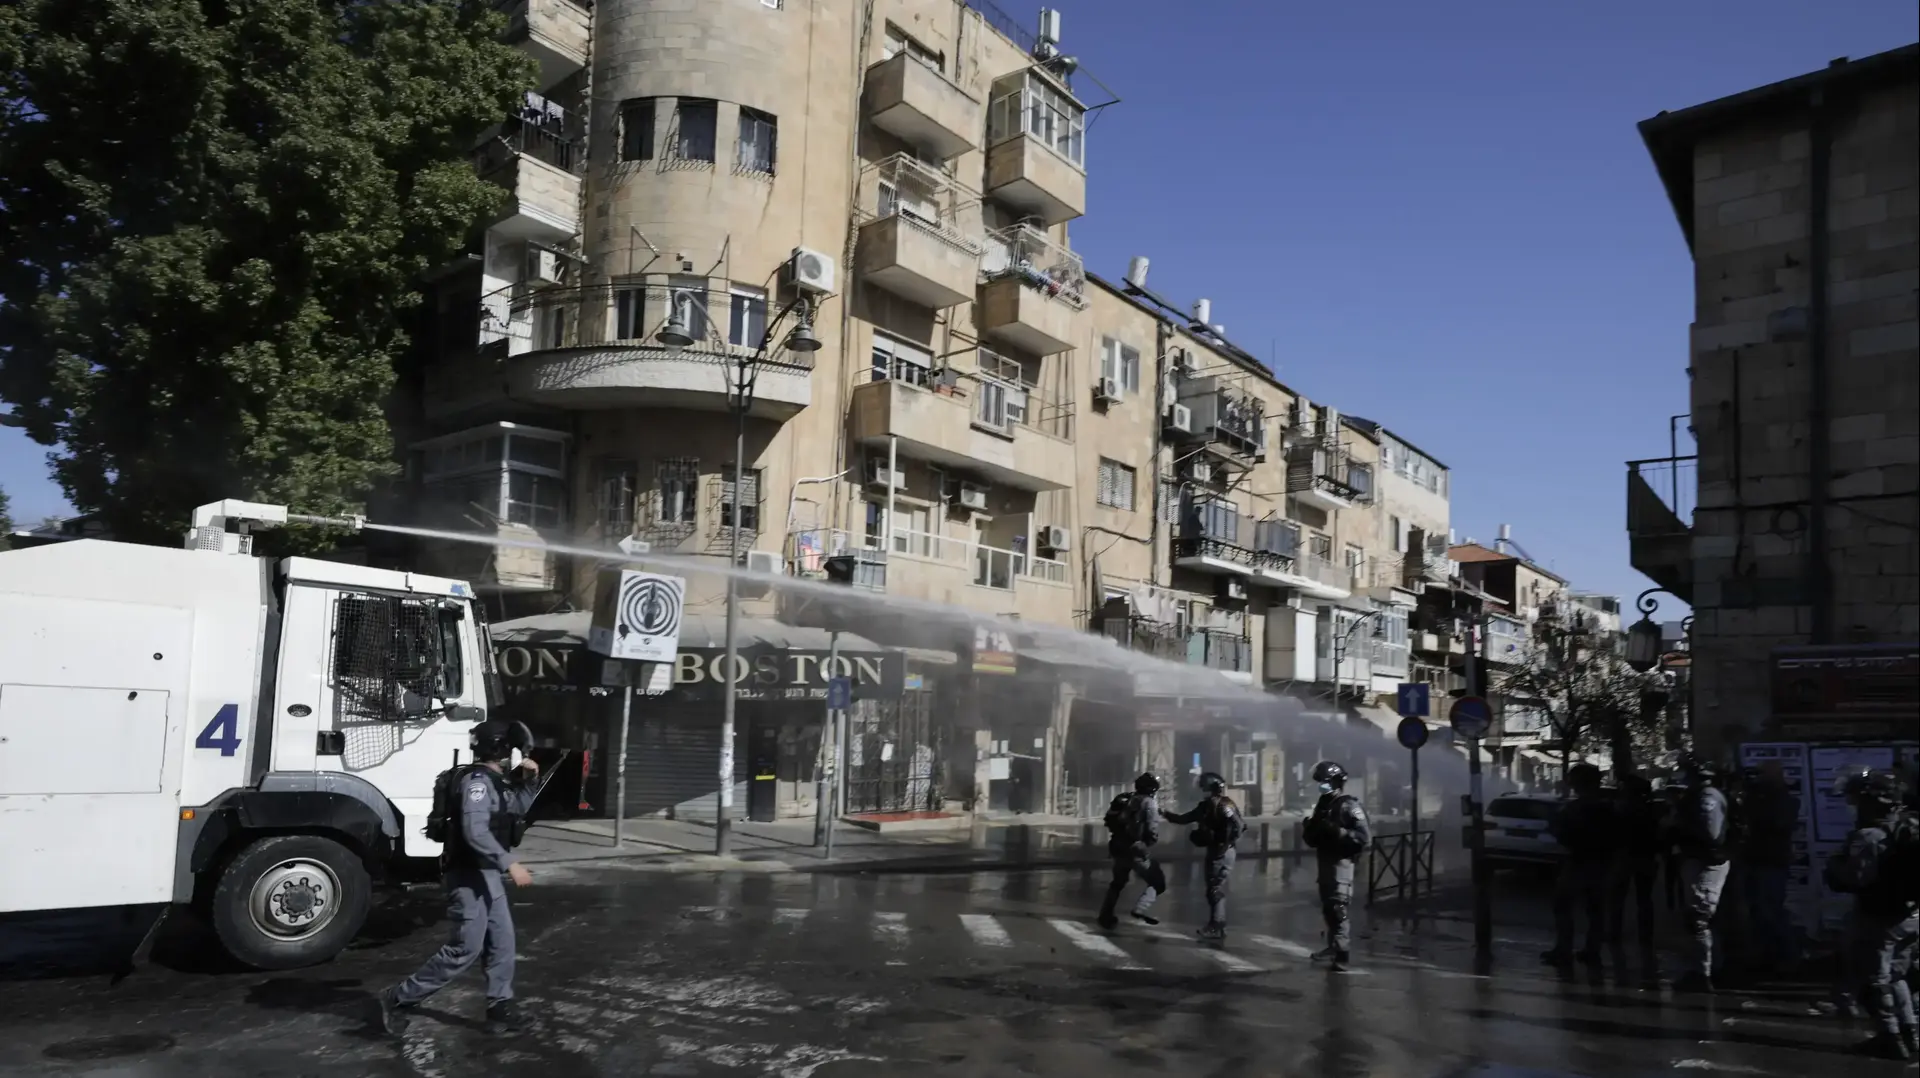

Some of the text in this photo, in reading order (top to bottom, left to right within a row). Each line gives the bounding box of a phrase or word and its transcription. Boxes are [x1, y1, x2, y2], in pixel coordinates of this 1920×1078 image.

[496, 646, 575, 681] ON
[674, 652, 885, 685] BOSTON
[195, 703, 242, 757] 4
